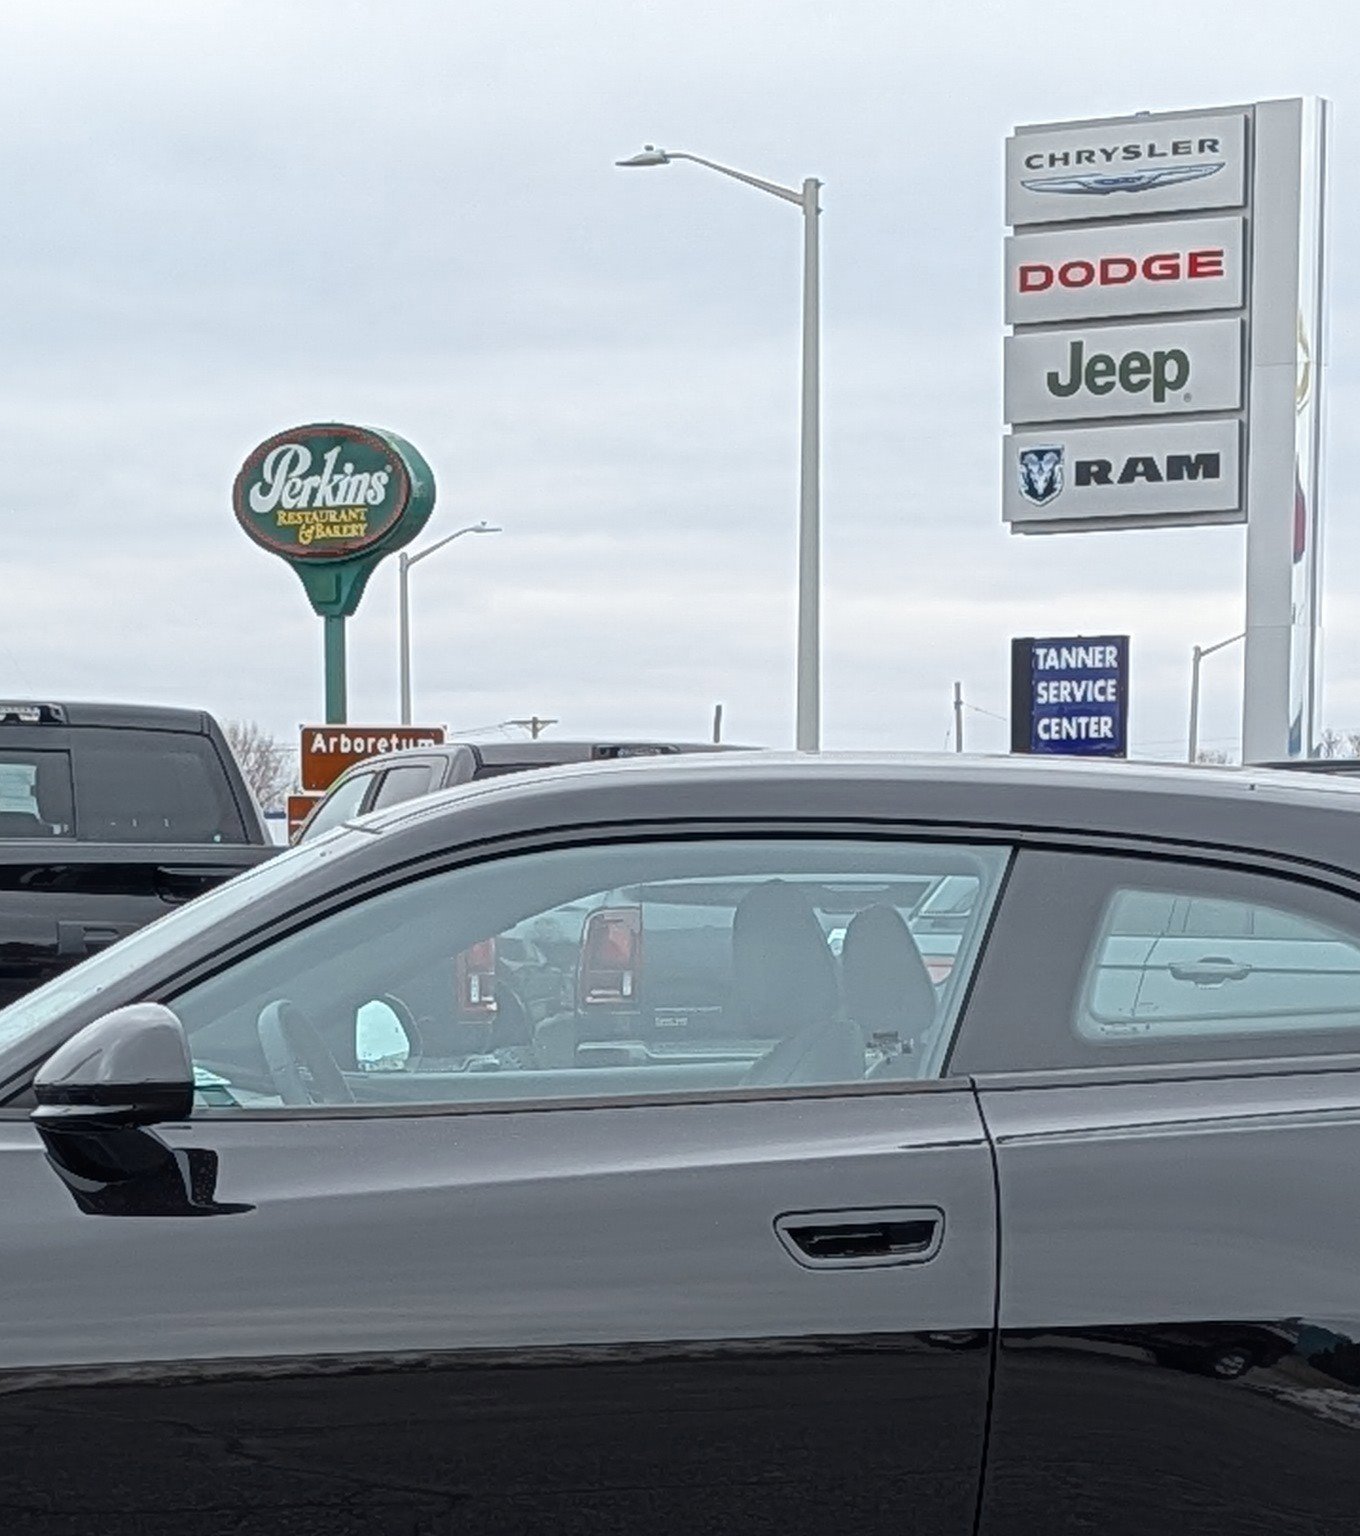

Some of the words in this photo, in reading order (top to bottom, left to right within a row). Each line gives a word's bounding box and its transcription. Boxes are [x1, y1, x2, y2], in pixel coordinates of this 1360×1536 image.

[1024, 137, 1220, 170] CHRYSLER
[1018, 249, 1225, 294] DODGE
[1046, 340, 1190, 403] Jeep
[249, 443, 389, 514] Perkins
[1074, 453, 1221, 487] RAM
[276, 507, 369, 527] RESTAURANT
[1035, 645, 1118, 670] TANNER
[1036, 678, 1117, 704] SERVICE
[1037, 715, 1114, 740] CENTER
